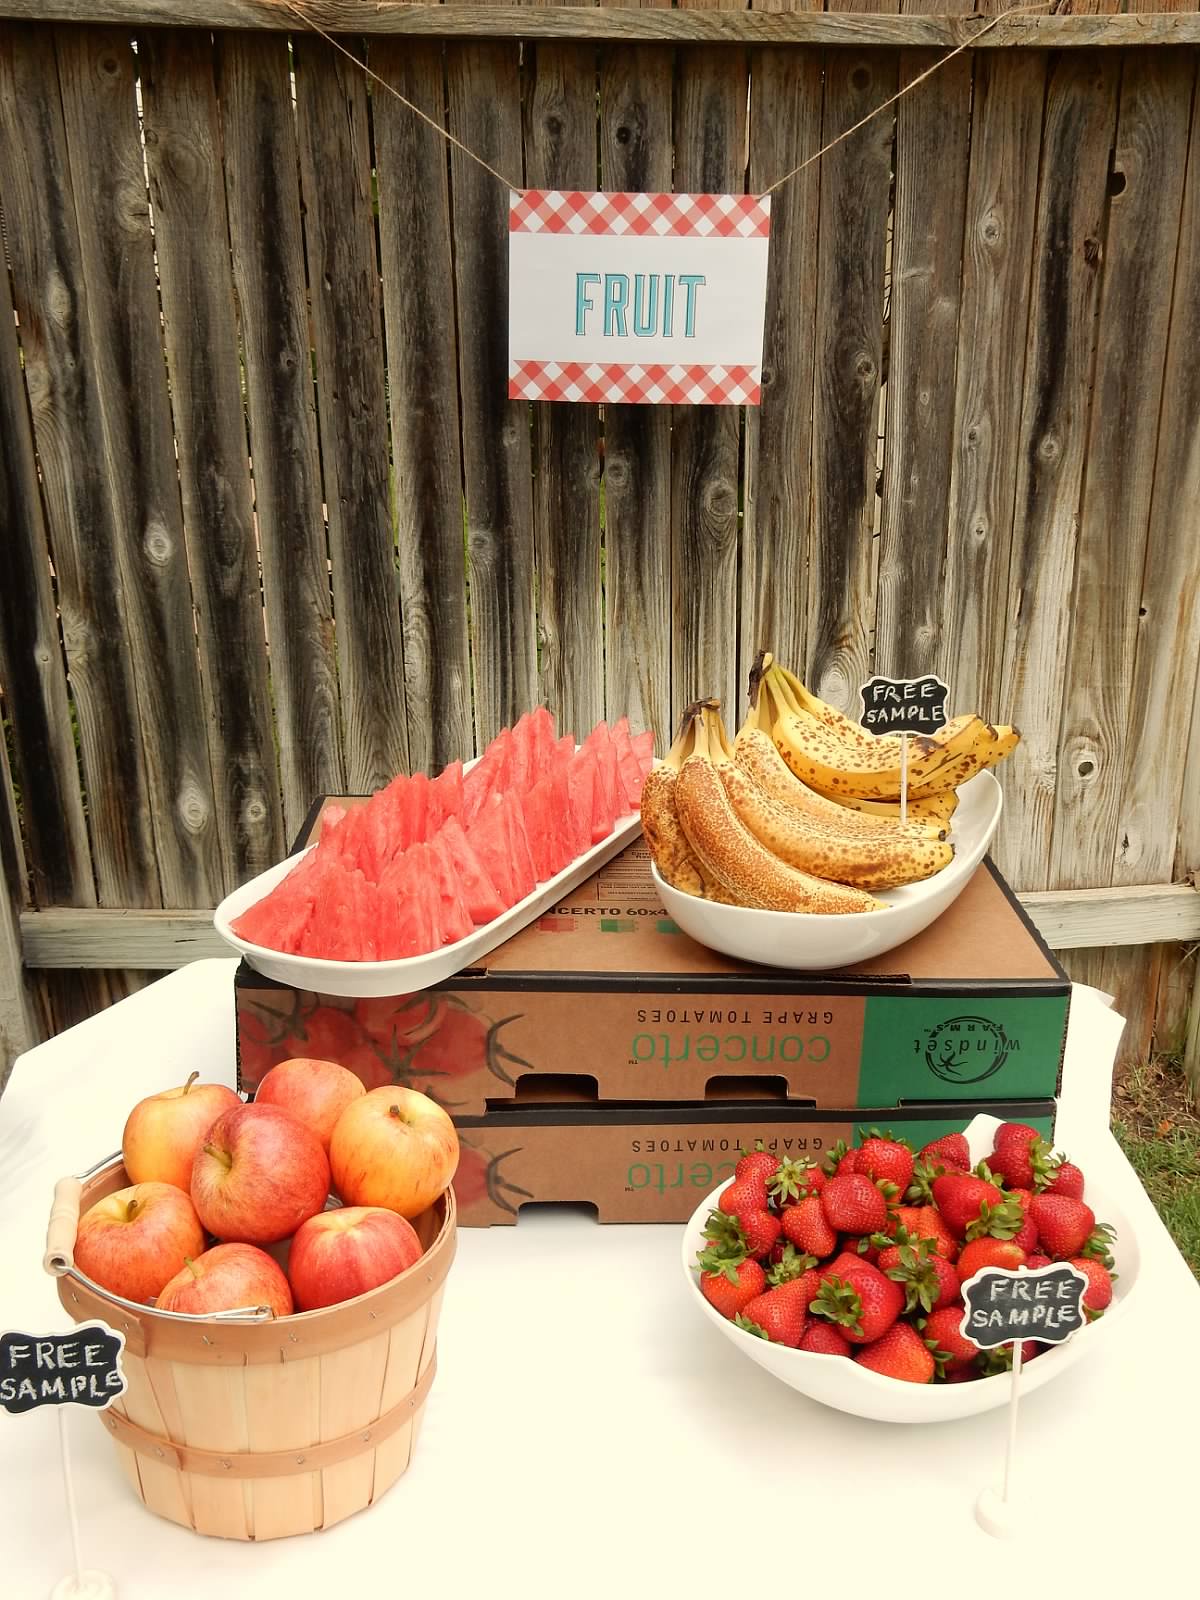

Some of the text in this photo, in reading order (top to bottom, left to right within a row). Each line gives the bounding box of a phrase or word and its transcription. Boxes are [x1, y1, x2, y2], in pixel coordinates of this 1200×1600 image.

[576, 273, 706, 338] FRUIT
[873, 683, 938, 703] FREE
[866, 705, 944, 723] SAMPLE
[549, 907, 621, 915] NCERTO
[637, 1009, 833, 1025] GRAPE TOMATOES
[937, 1023, 1004, 1032] FARMS
[632, 1032, 831, 1071] concerto
[914, 1039, 1021, 1055] windset
[632, 1139, 743, 1152] TOMATOES
[628, 1160, 737, 1195] certo
[990, 1279, 1076, 1301] FREE
[972, 1305, 1078, 1328] SAMPLE
[9, 1342, 109, 1370] FREE
[0, 1370, 122, 1400] SAMPLE
